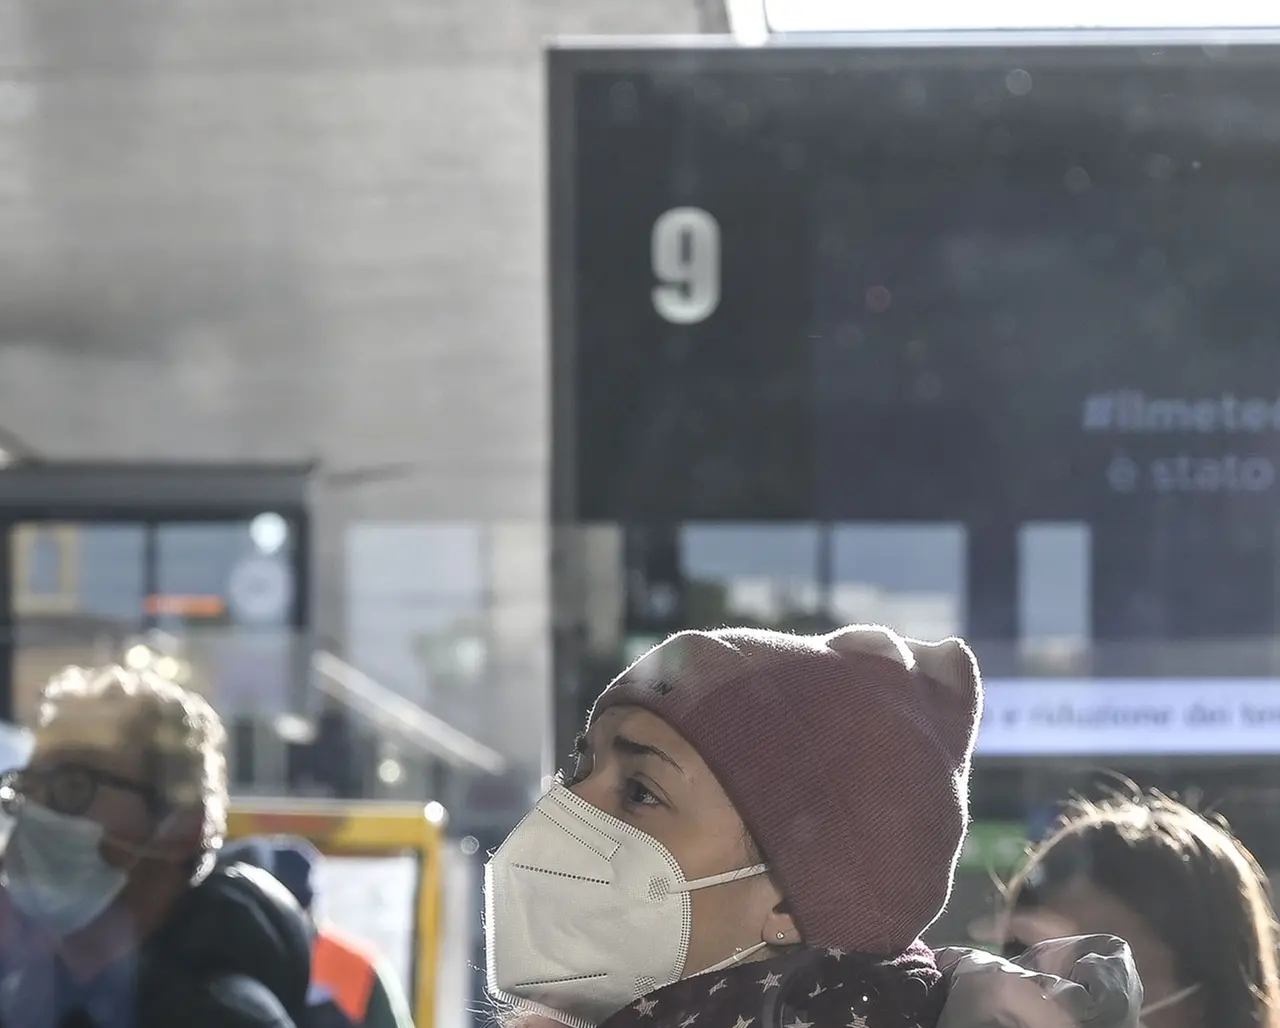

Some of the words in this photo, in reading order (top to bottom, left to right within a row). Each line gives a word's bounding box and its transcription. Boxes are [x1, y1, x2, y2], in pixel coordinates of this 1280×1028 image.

[651, 206, 721, 325] 9
[1108, 451, 1138, 492] è
[1151, 454, 1276, 492] stato
